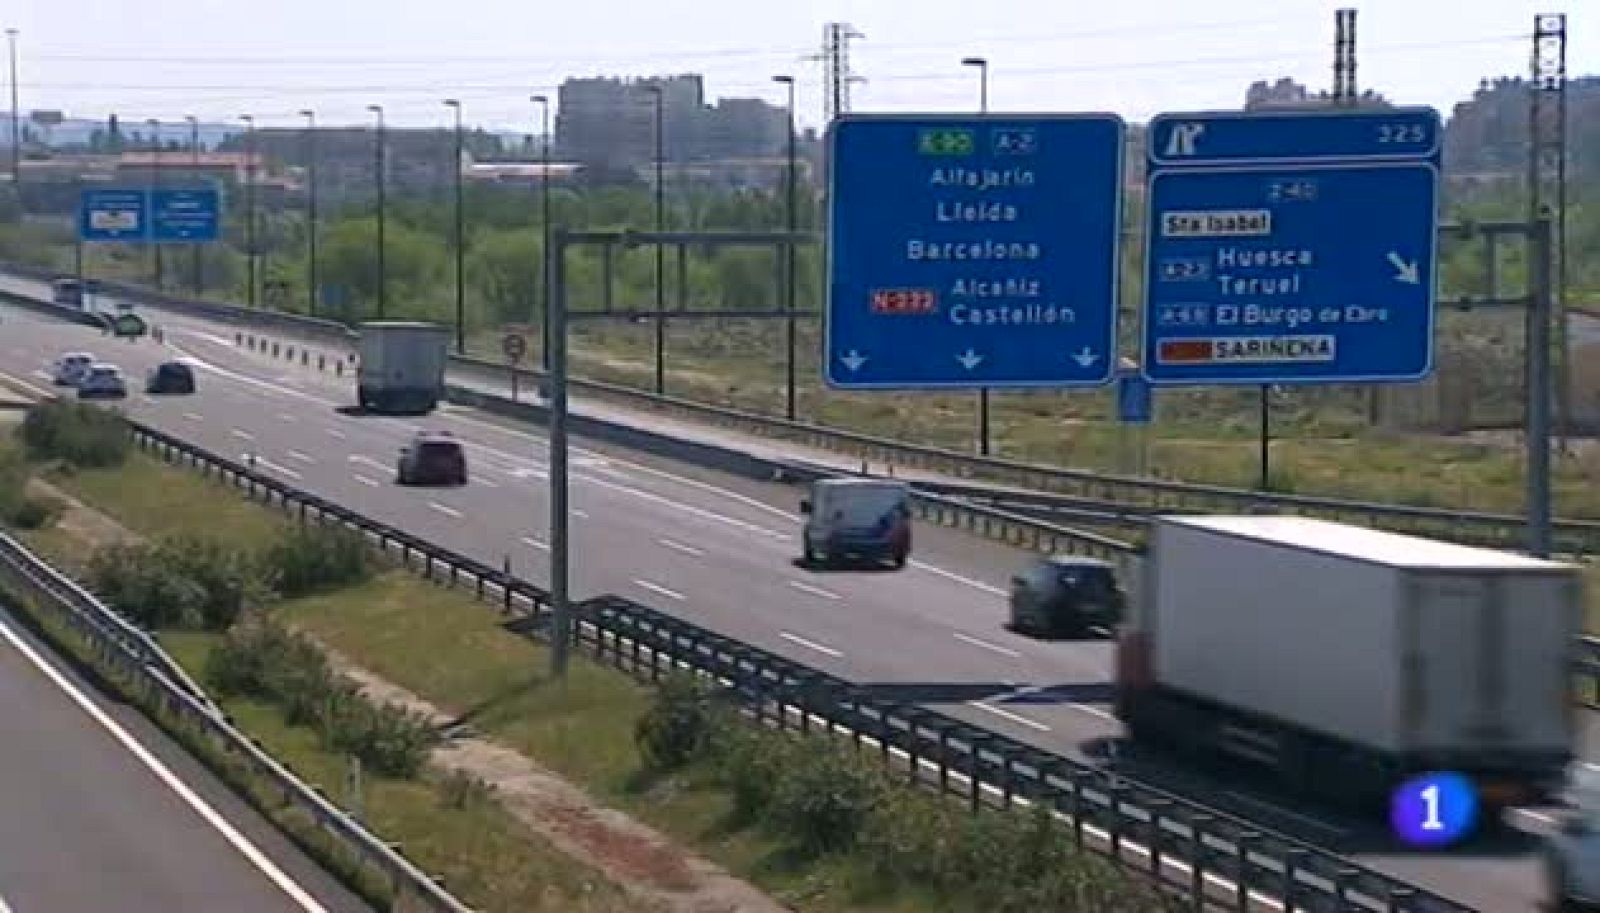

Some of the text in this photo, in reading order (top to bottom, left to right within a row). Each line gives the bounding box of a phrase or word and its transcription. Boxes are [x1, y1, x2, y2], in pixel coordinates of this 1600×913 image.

[1378, 124, 1425, 143] 325
[936, 200, 1018, 222] Lleida
[1206, 213, 1267, 232] Isabel
[907, 240, 1041, 260] Barcelona
[1217, 248, 1311, 267] Huesca
[951, 277, 1041, 297] Alcañiz
[1217, 273, 1300, 295] Teruel
[950, 303, 1075, 326] Castellón
[1216, 305, 1239, 323] El
[1243, 304, 1312, 328] Burgo
